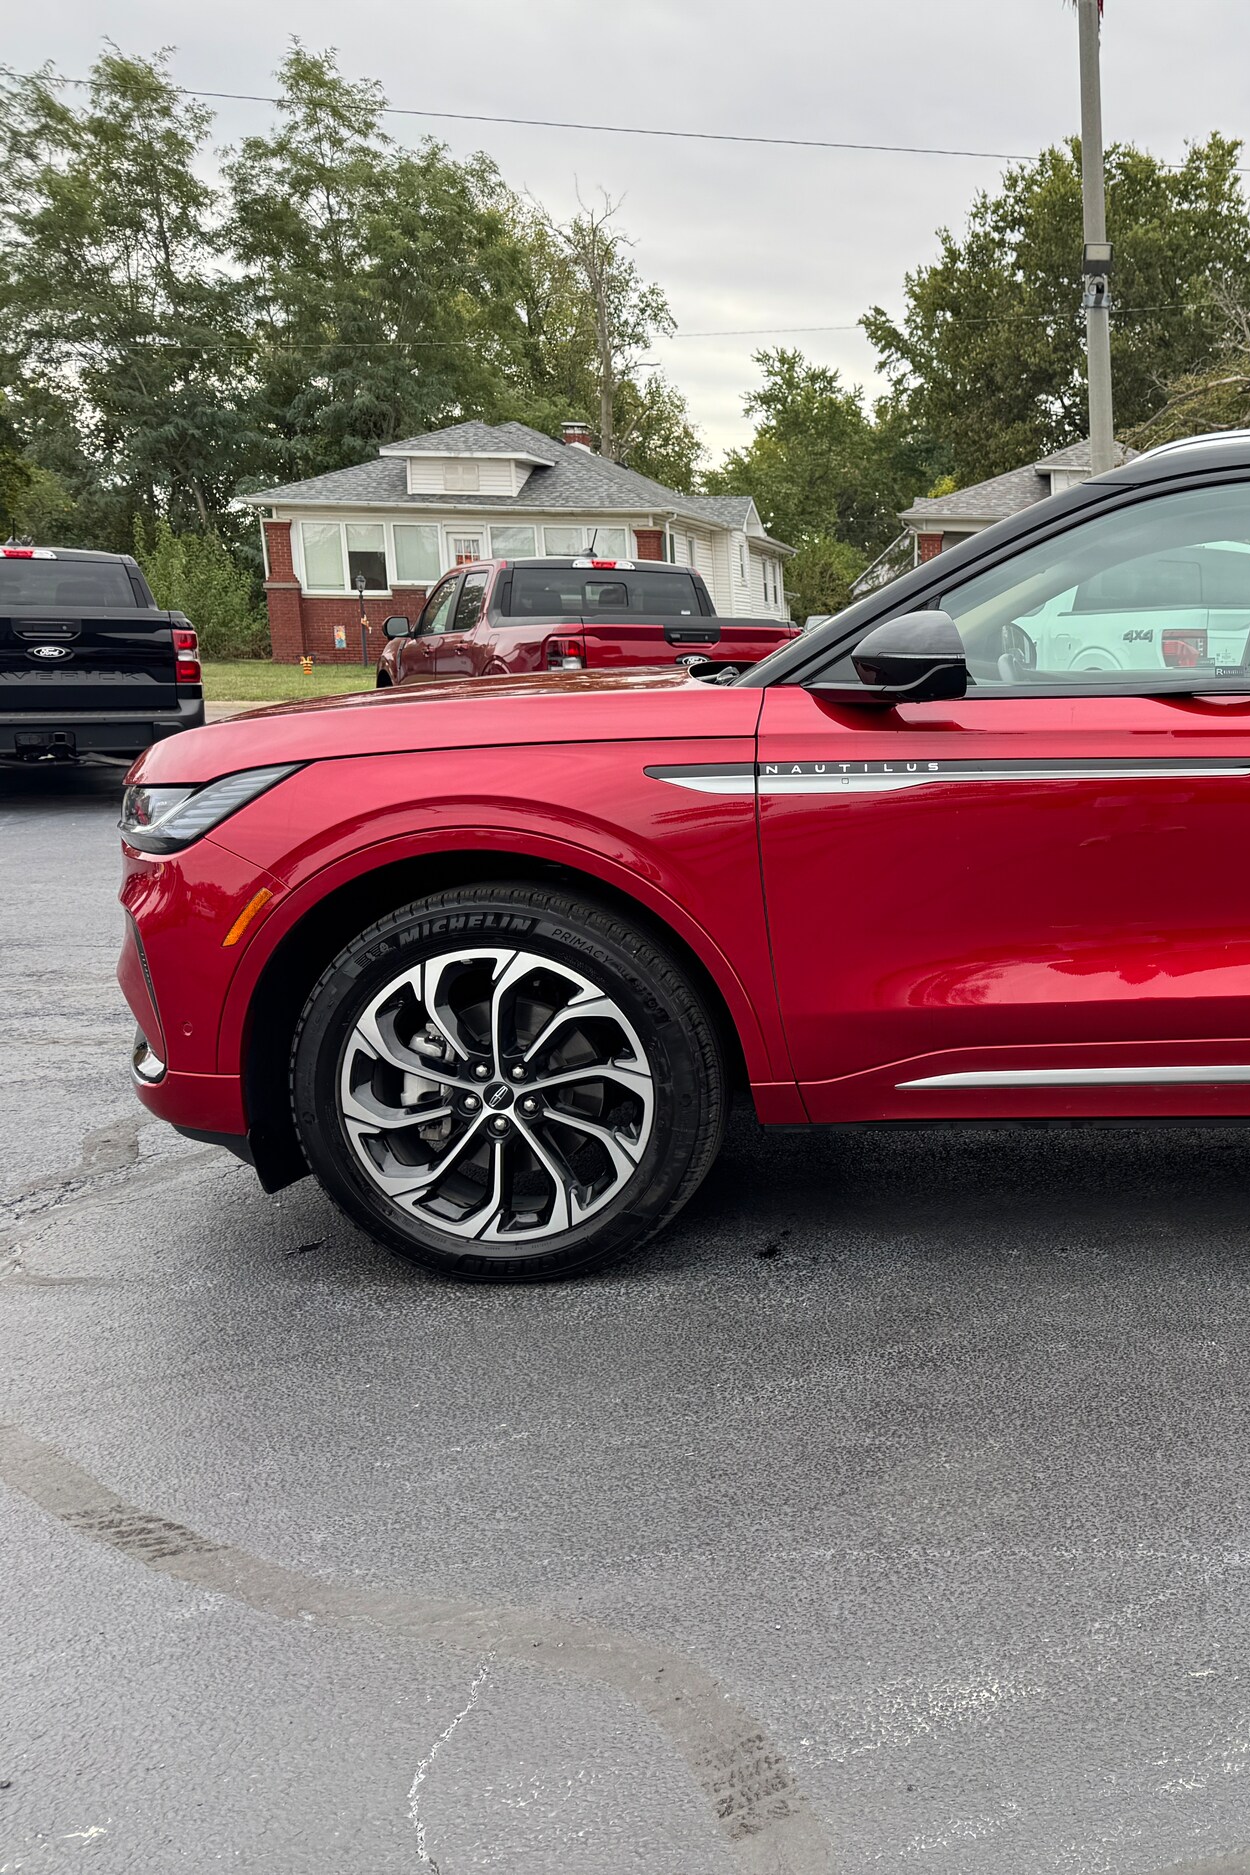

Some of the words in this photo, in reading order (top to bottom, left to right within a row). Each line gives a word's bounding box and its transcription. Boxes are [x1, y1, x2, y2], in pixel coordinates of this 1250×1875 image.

[38, 647, 60, 657] Ford
[766, 763, 939, 774] NAUTILUS
[401, 915, 532, 945] MICHELIN
[552, 928, 613, 964] PRIMACY
